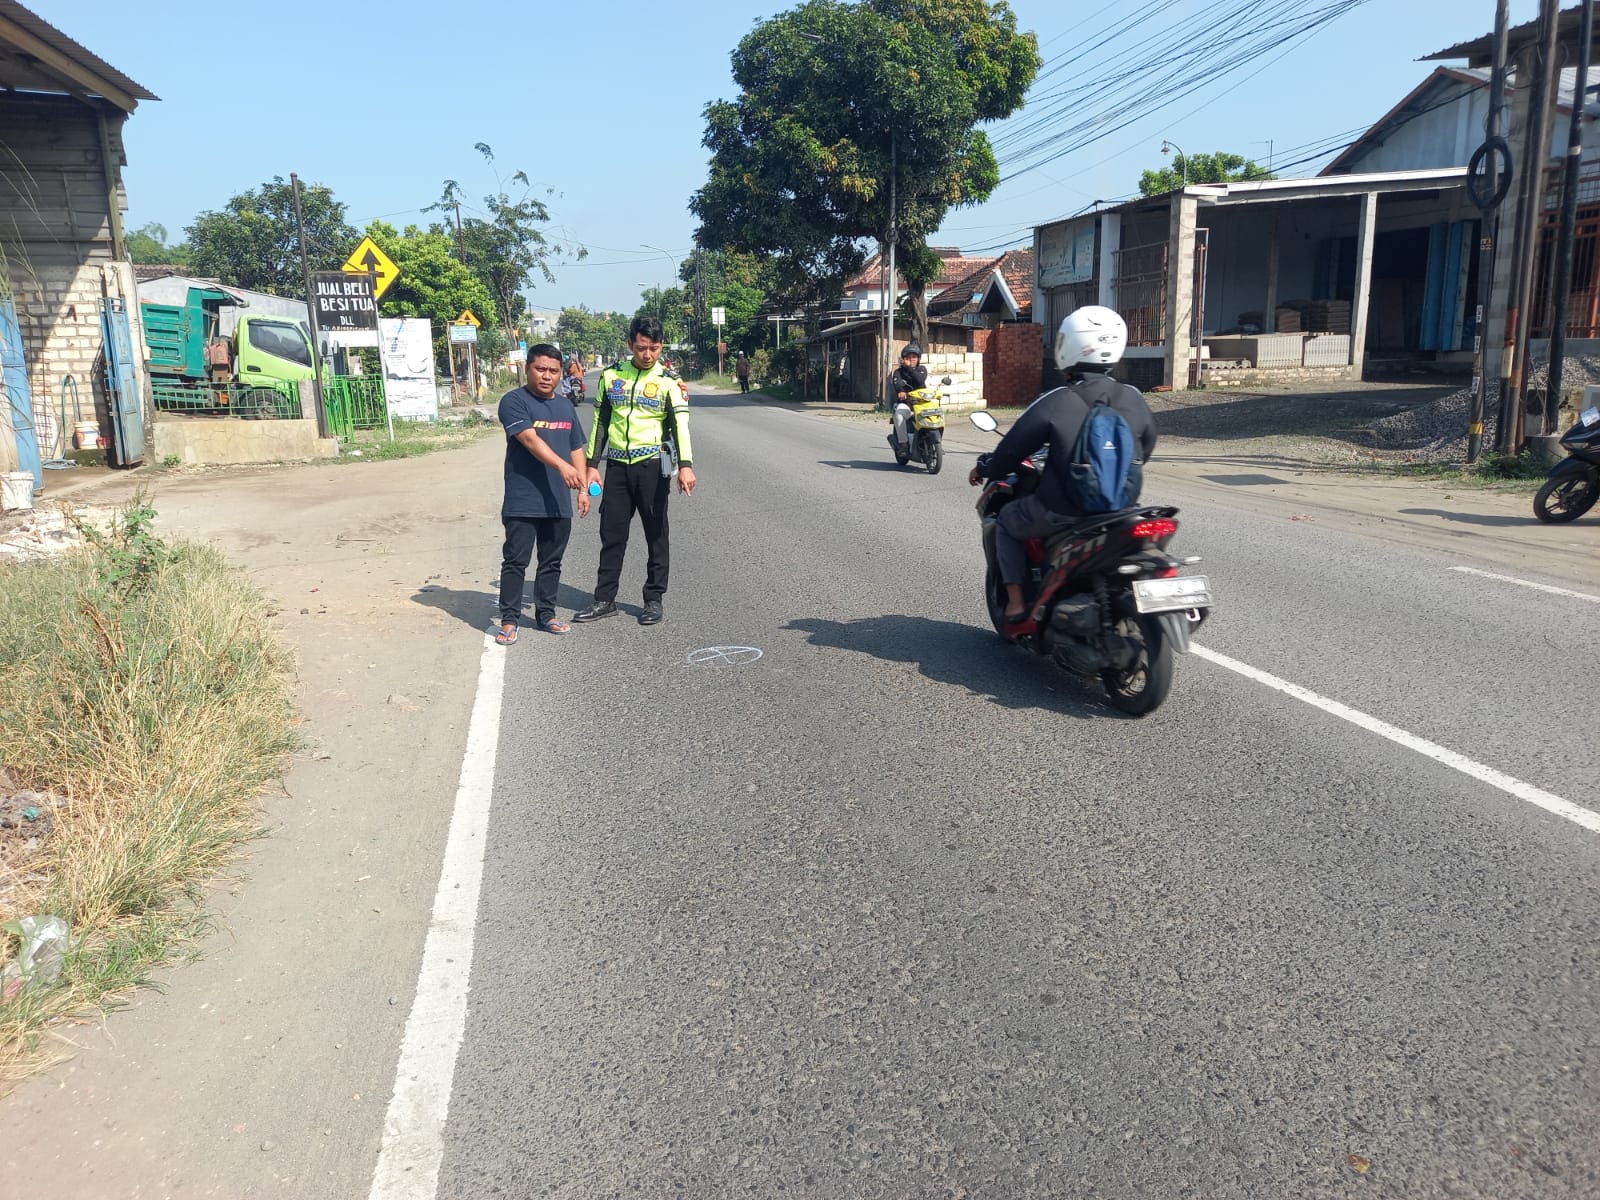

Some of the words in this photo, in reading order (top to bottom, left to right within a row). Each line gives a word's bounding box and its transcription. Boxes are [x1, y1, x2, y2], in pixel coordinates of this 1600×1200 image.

[316, 281, 343, 296] JUAL
[343, 282, 370, 296] BELI
[320, 297, 350, 312] BESI
[350, 297, 375, 312] TUA
[339, 315, 356, 326] DLL
